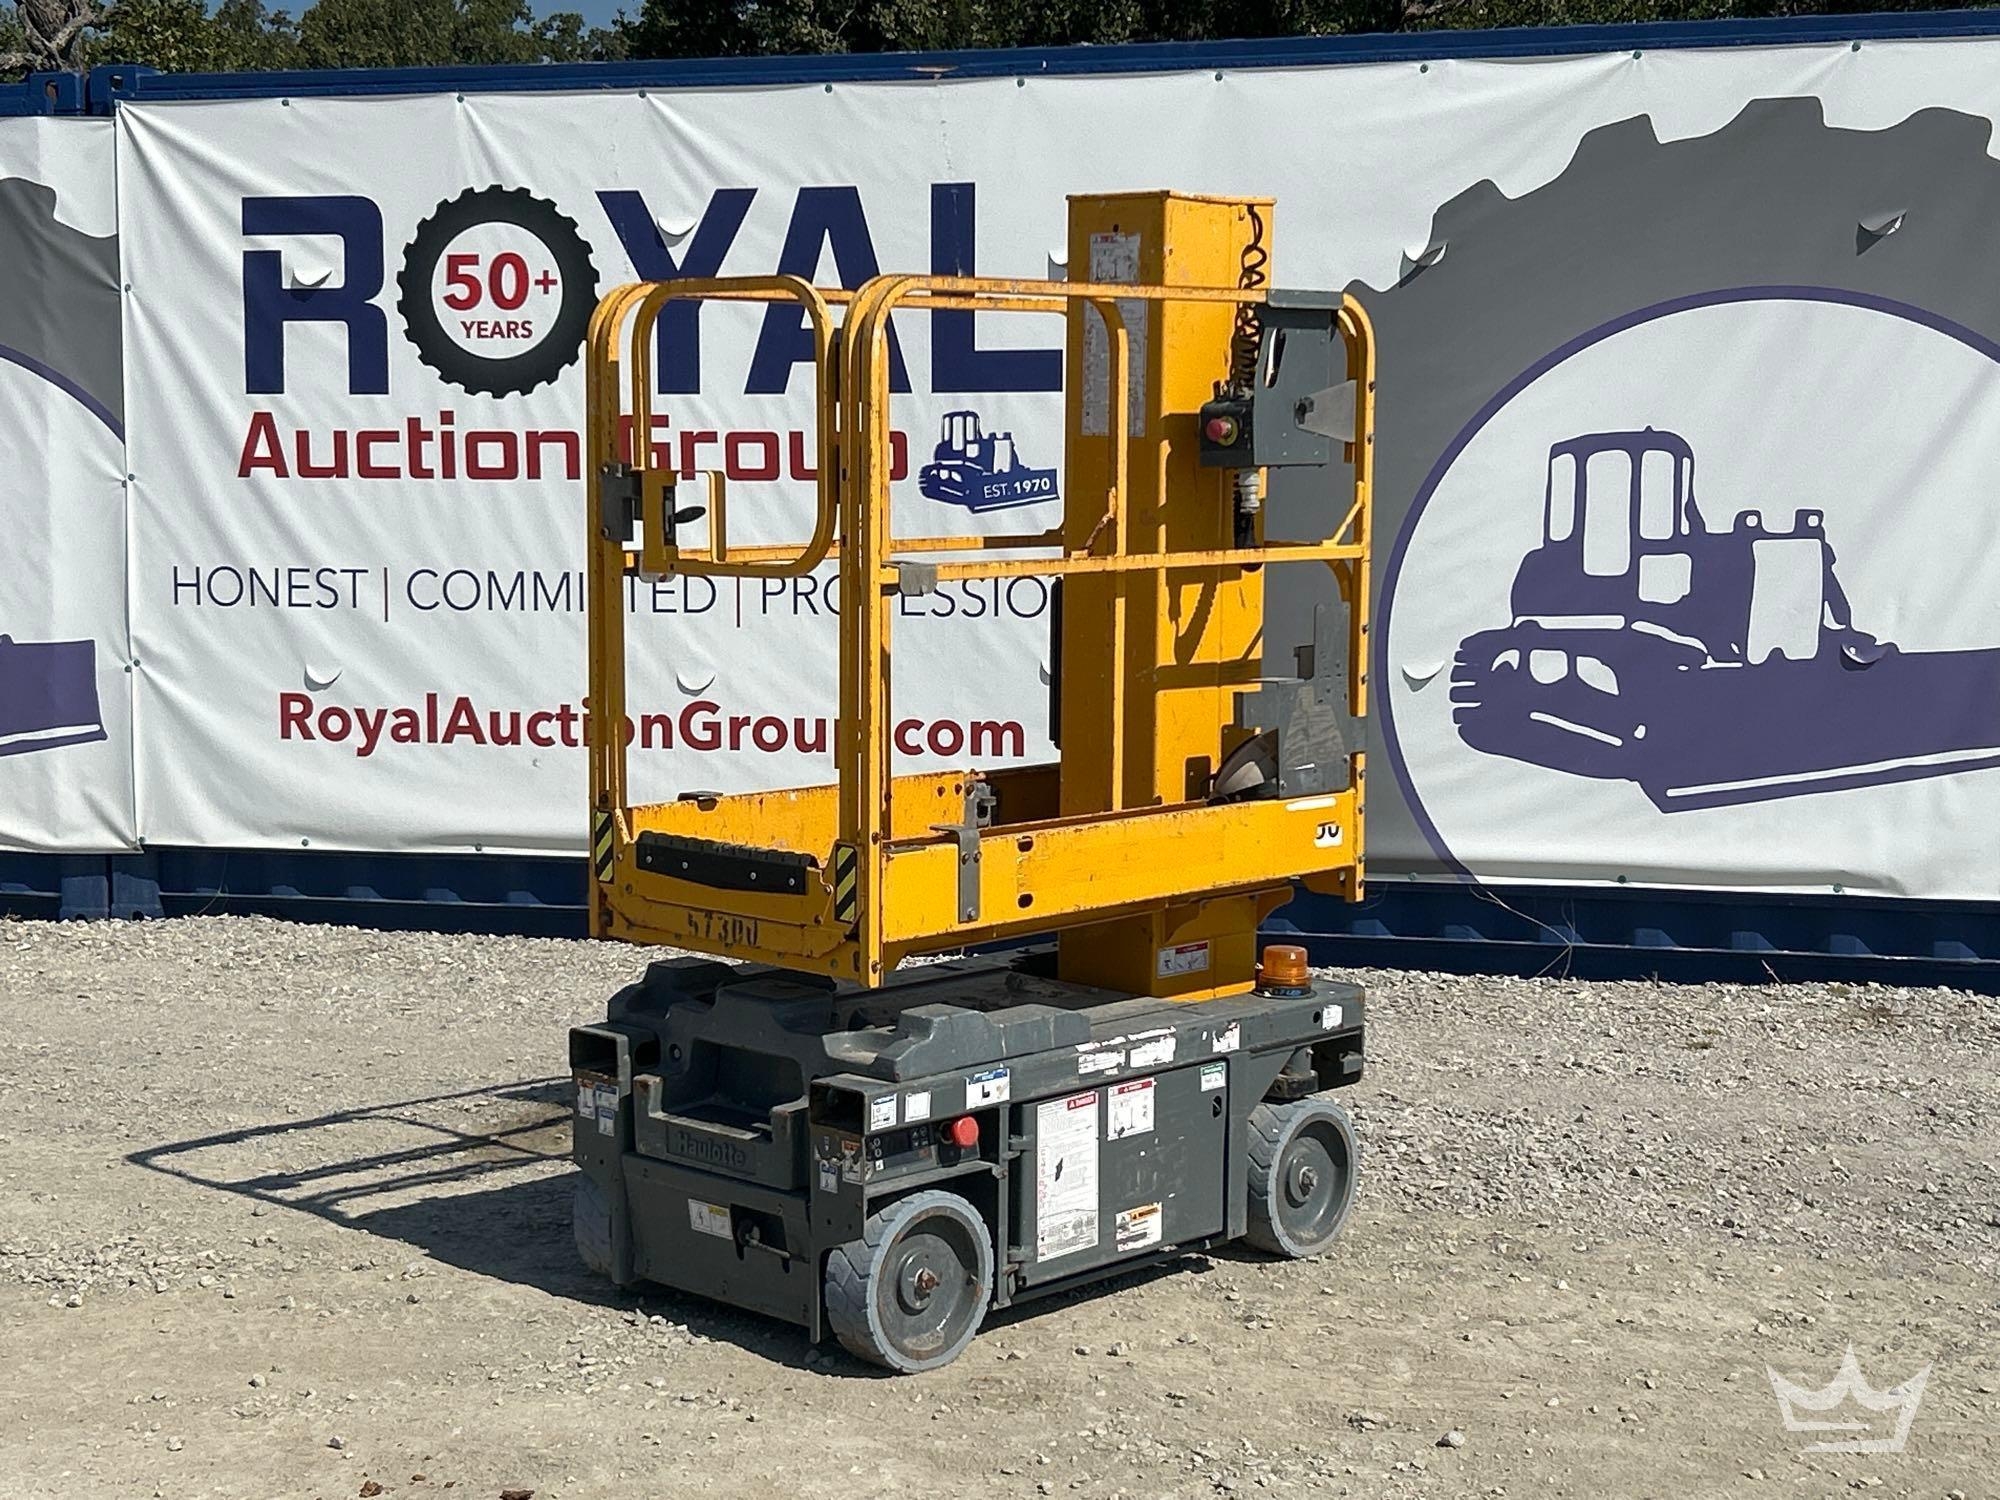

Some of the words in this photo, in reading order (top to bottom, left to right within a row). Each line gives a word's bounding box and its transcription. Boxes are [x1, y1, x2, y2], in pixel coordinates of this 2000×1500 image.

[443, 252, 558, 311] 50+
[461, 321, 533, 339] YEARS
[237, 410, 581, 480] Auction
[983, 482, 1011, 499] EST.
[1014, 477, 1050, 494] 1970
[173, 566, 368, 609] HONEST
[406, 569, 717, 613] COMMITED
[280, 692, 1025, 769] RoyalAuctinGroucom
[679, 1130, 747, 1168] Haulotte
